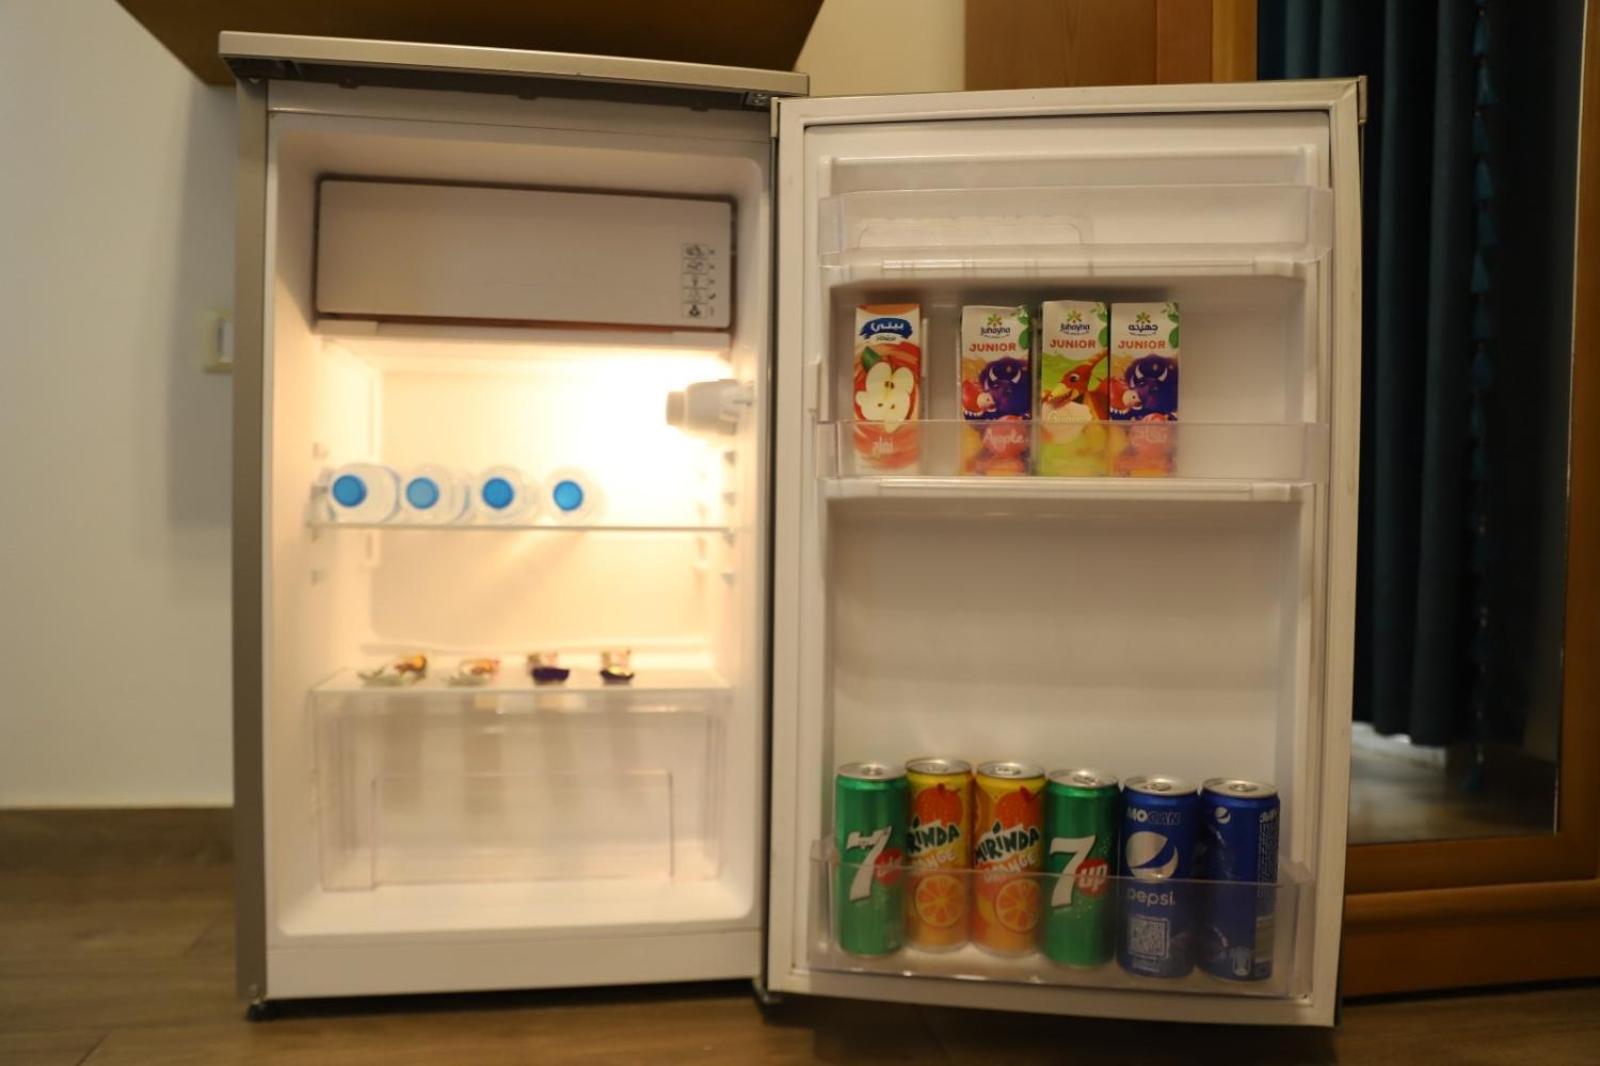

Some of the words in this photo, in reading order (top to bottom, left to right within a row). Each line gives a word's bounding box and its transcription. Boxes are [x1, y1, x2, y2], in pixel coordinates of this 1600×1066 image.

[969, 342, 1017, 352] JUNIOR
[1050, 339, 1096, 349] JUNIOR
[1118, 340, 1165, 350] JUNIOR
